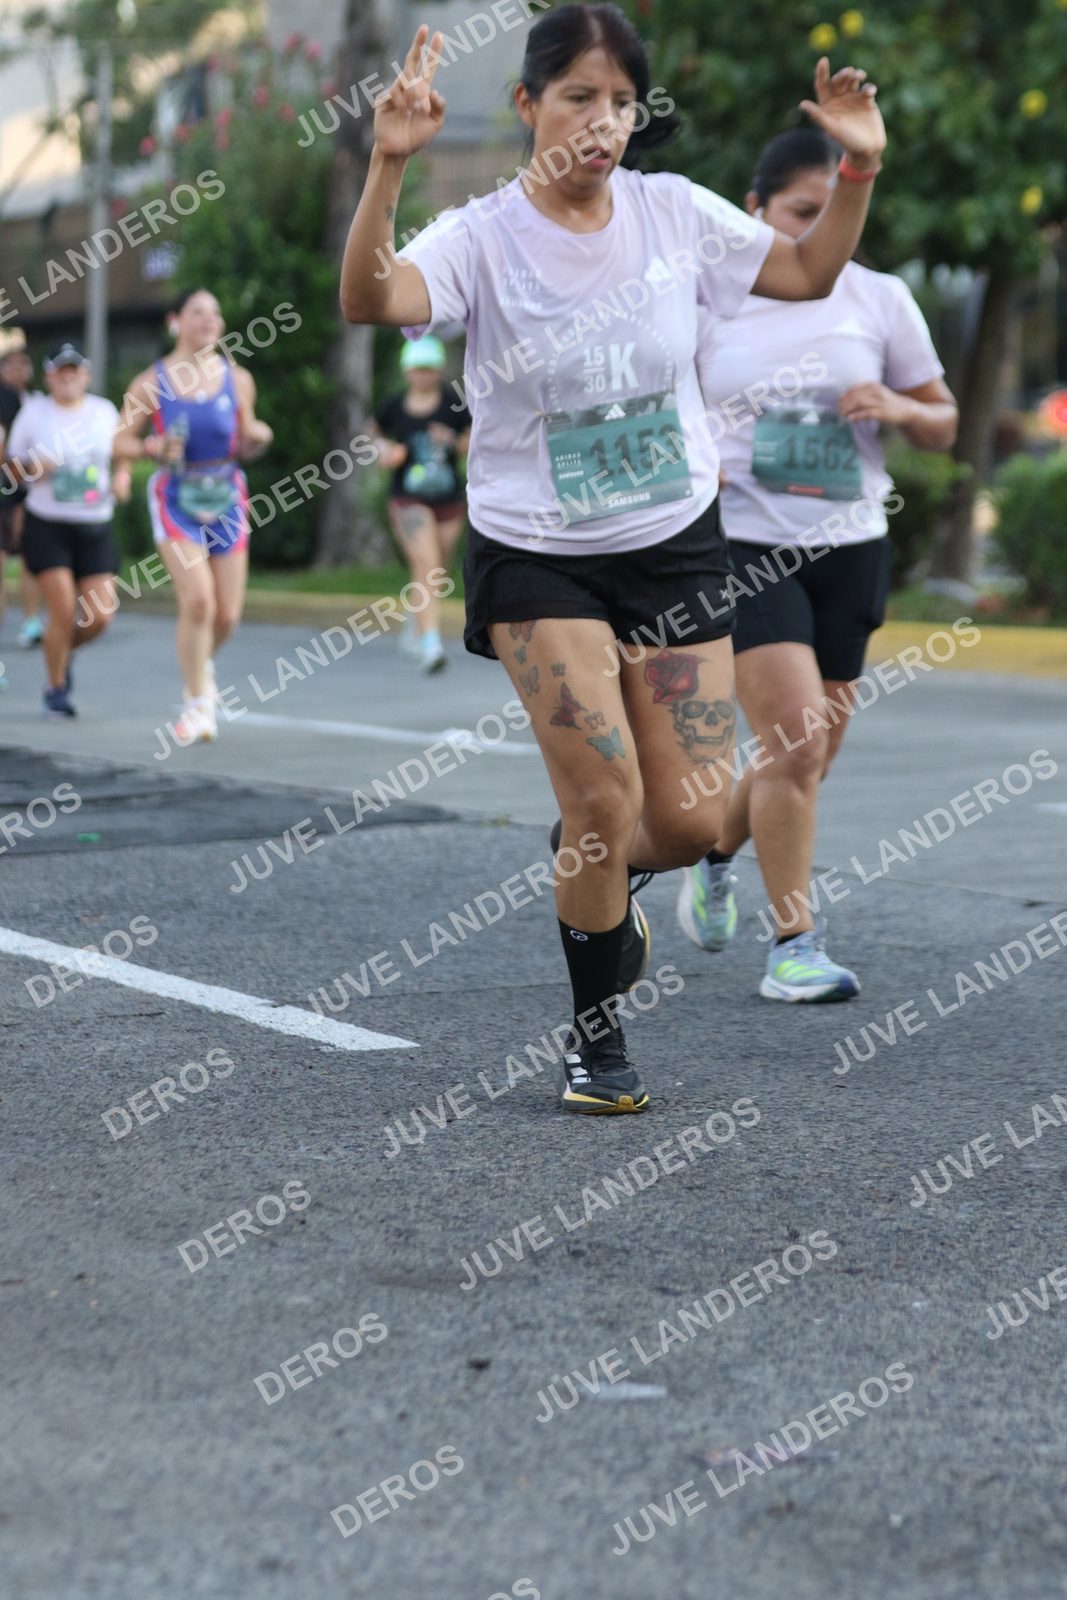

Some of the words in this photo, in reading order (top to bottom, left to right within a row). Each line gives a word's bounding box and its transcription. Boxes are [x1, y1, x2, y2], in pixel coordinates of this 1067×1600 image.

[583, 345, 605, 367] 15
[609, 341, 640, 391] K
[583, 373, 606, 393] 30
[608, 491, 651, 508] SAMSUNG
